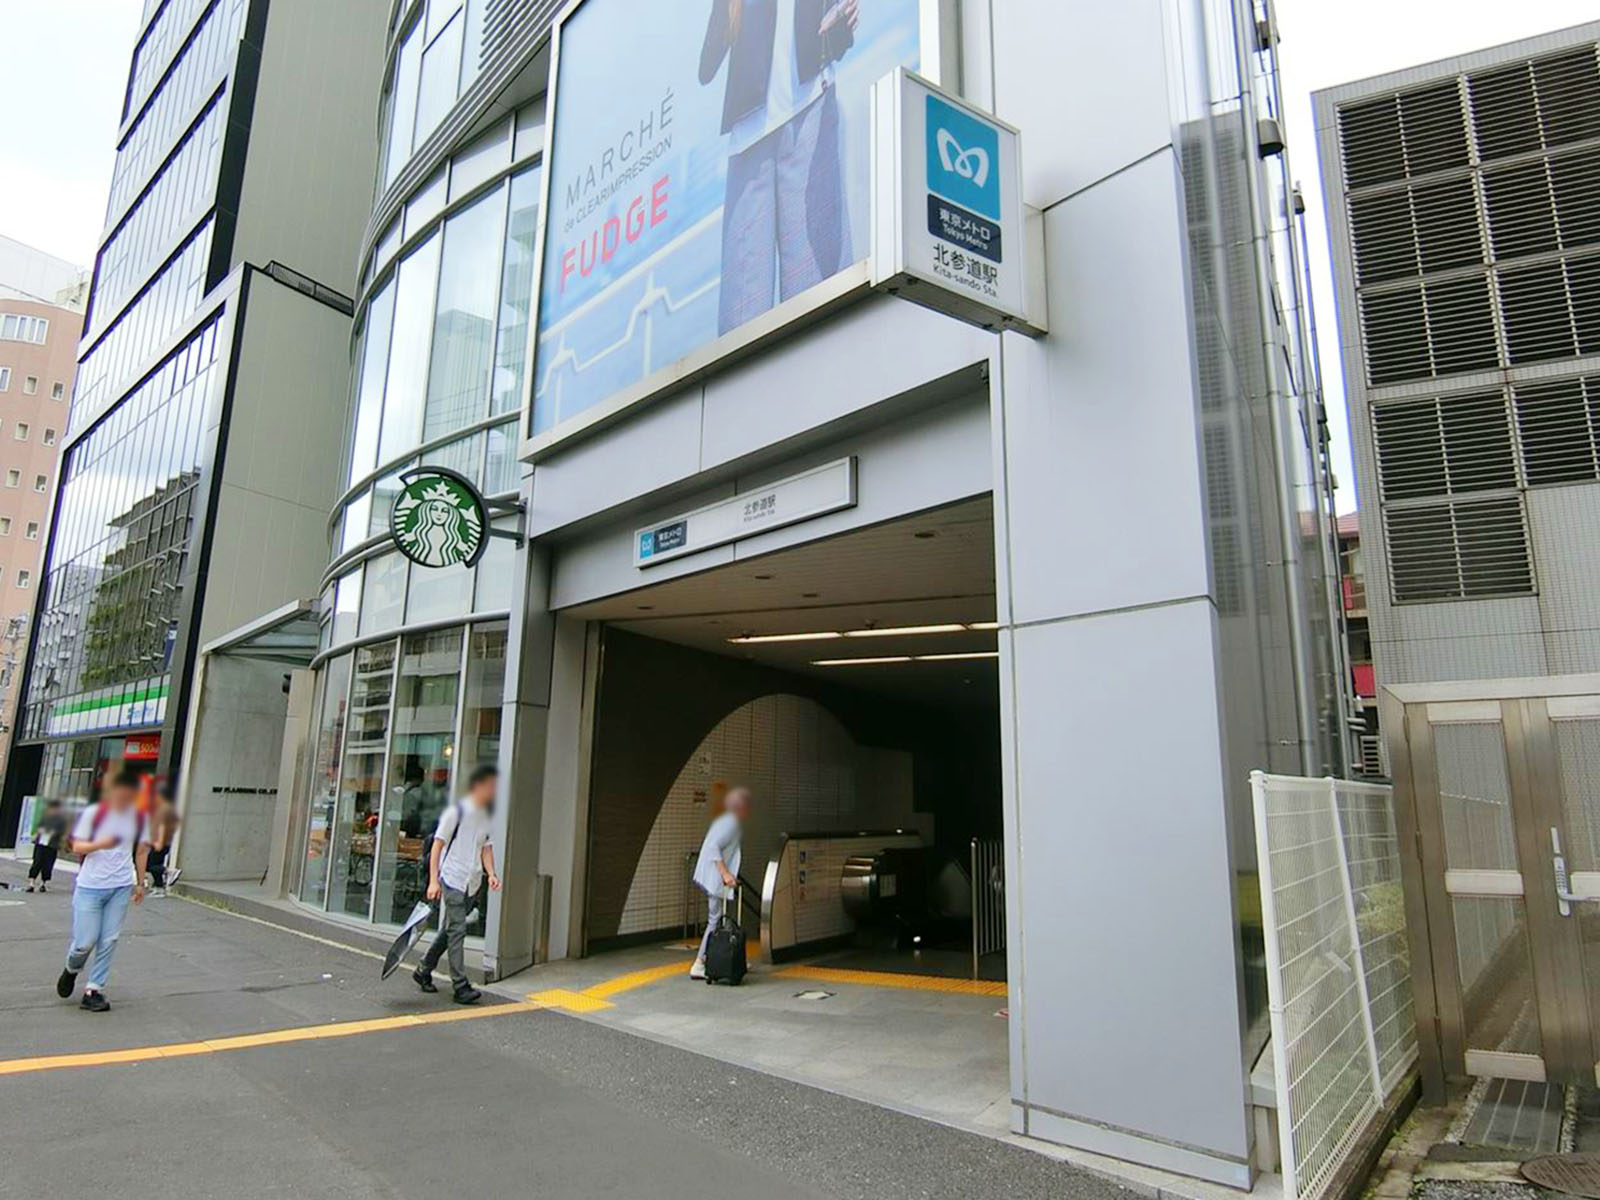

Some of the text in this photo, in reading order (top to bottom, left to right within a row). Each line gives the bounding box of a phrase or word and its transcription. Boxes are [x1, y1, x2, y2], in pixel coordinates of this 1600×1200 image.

[565, 86, 674, 210] MARCHÉ
[559, 173, 670, 295] FUDGE
[938, 207, 990, 241] 東京メトロ
[943, 222, 989, 250] Tokyo Metro
[933, 243, 999, 288] 北参道駅
